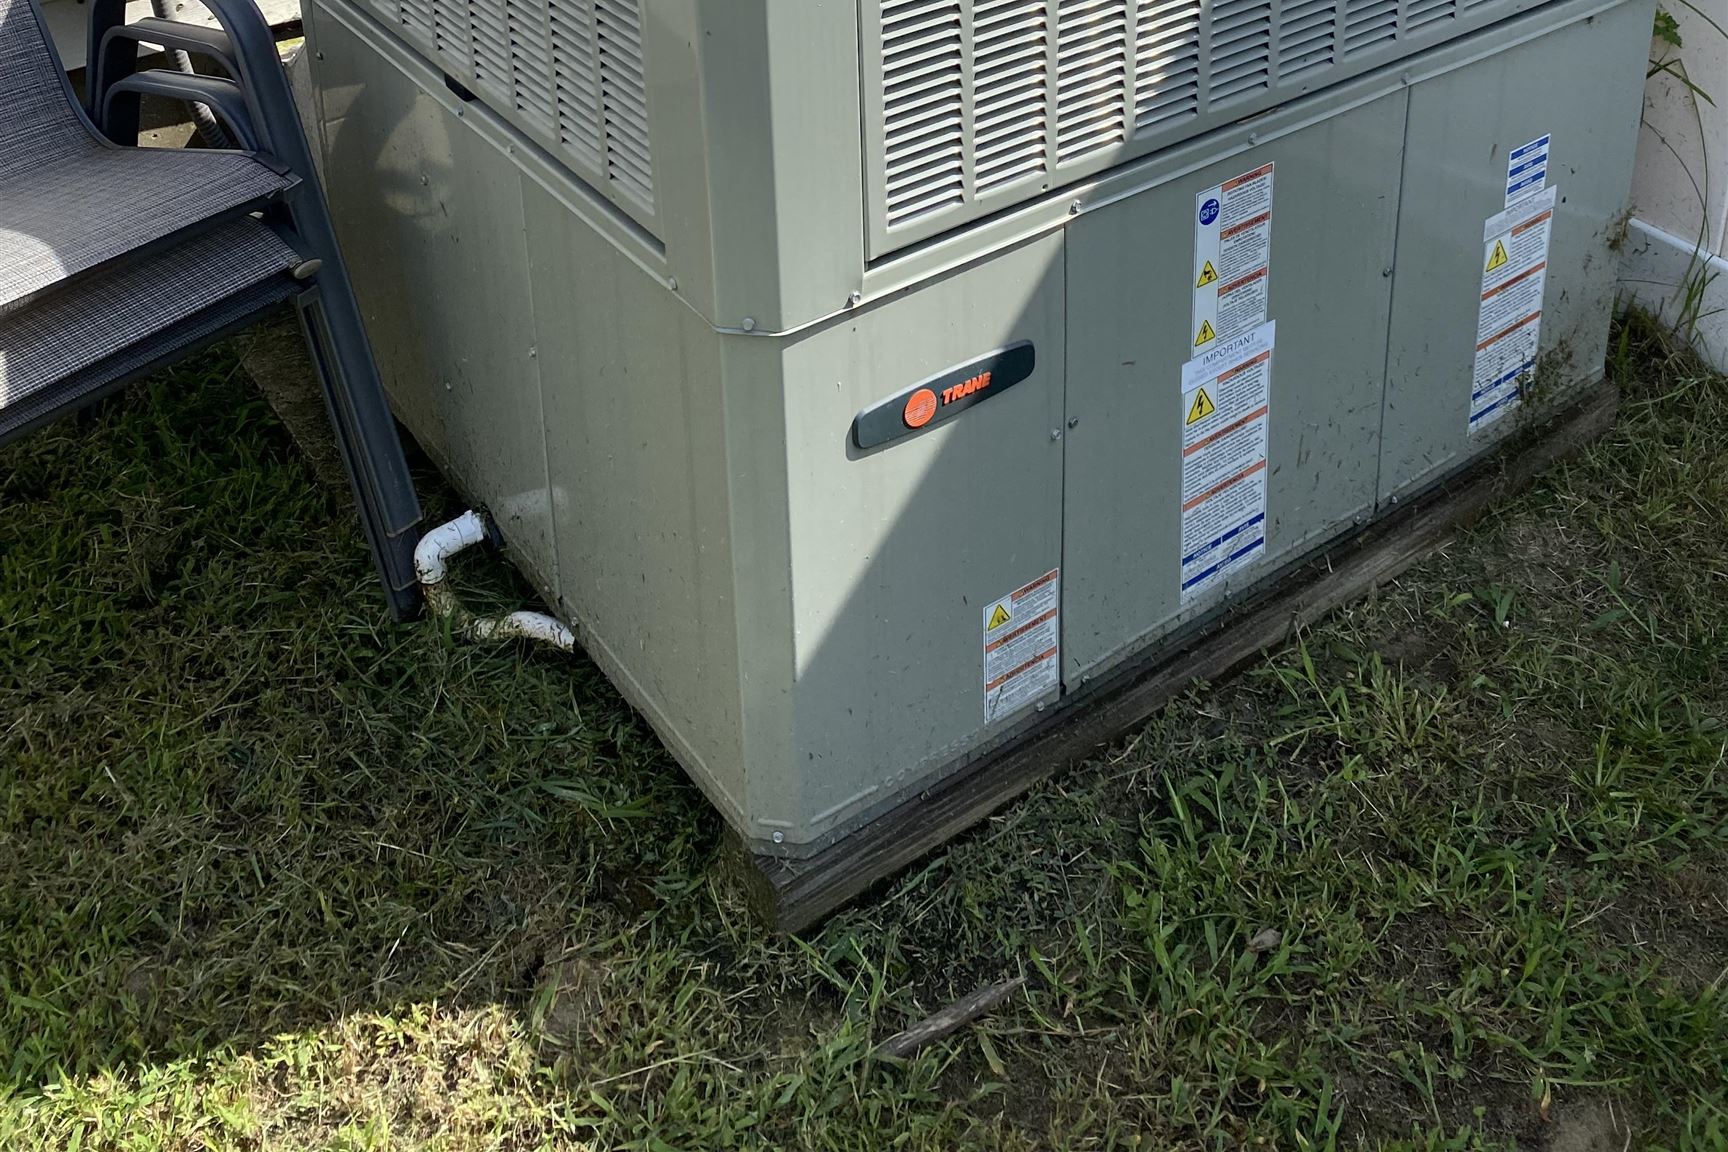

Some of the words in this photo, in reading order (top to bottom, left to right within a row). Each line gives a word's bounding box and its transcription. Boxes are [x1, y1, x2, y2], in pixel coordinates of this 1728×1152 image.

[1203, 332, 1256, 366] IMPORTANT
[943, 371, 991, 405] TRANE
[1023, 575, 1050, 594] WARNING
